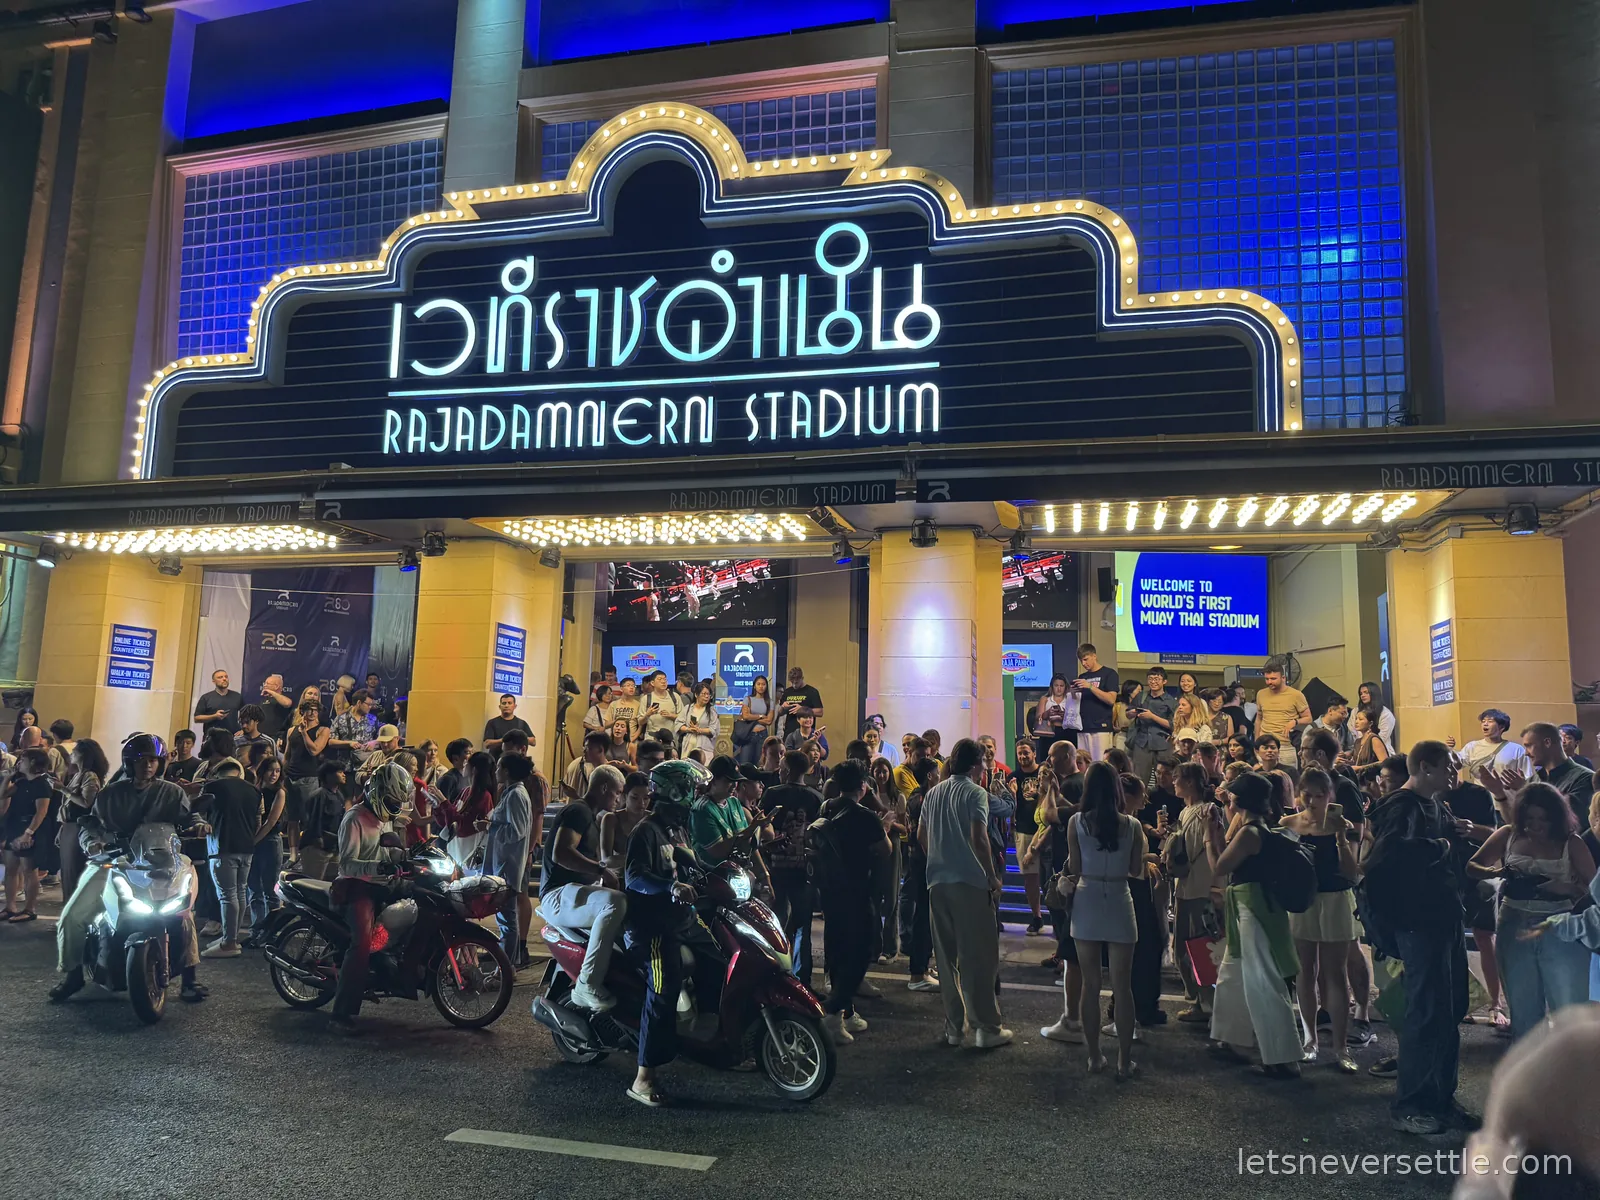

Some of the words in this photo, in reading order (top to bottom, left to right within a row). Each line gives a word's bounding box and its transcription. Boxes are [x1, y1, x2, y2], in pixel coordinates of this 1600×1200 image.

[389, 221, 942, 379] เวทีราชดำเนิน
[383, 395, 714, 455] RAJADAMNERN
[746, 382, 941, 443] STADIUM
[1380, 462, 1553, 488] RAJADAMNERN
[669, 487, 798, 510] RAJADAMNERN
[813, 483, 886, 504] STADIUM
[128, 506, 227, 526] RAJADAMNERN
[236, 504, 292, 522] STADIUM
[1140, 578, 1195, 592] WELCOME
[1199, 580, 1212, 593] TO
[1140, 594, 1194, 610] WORLD'S
[1199, 596, 1232, 611] FIRST
[1140, 610, 1174, 626] MUAY
[1178, 611, 1204, 627] THAI
[1208, 612, 1260, 629] STADIUM
[133, 639, 150, 647] TICKETS
[133, 671, 150, 679] TICKETS
